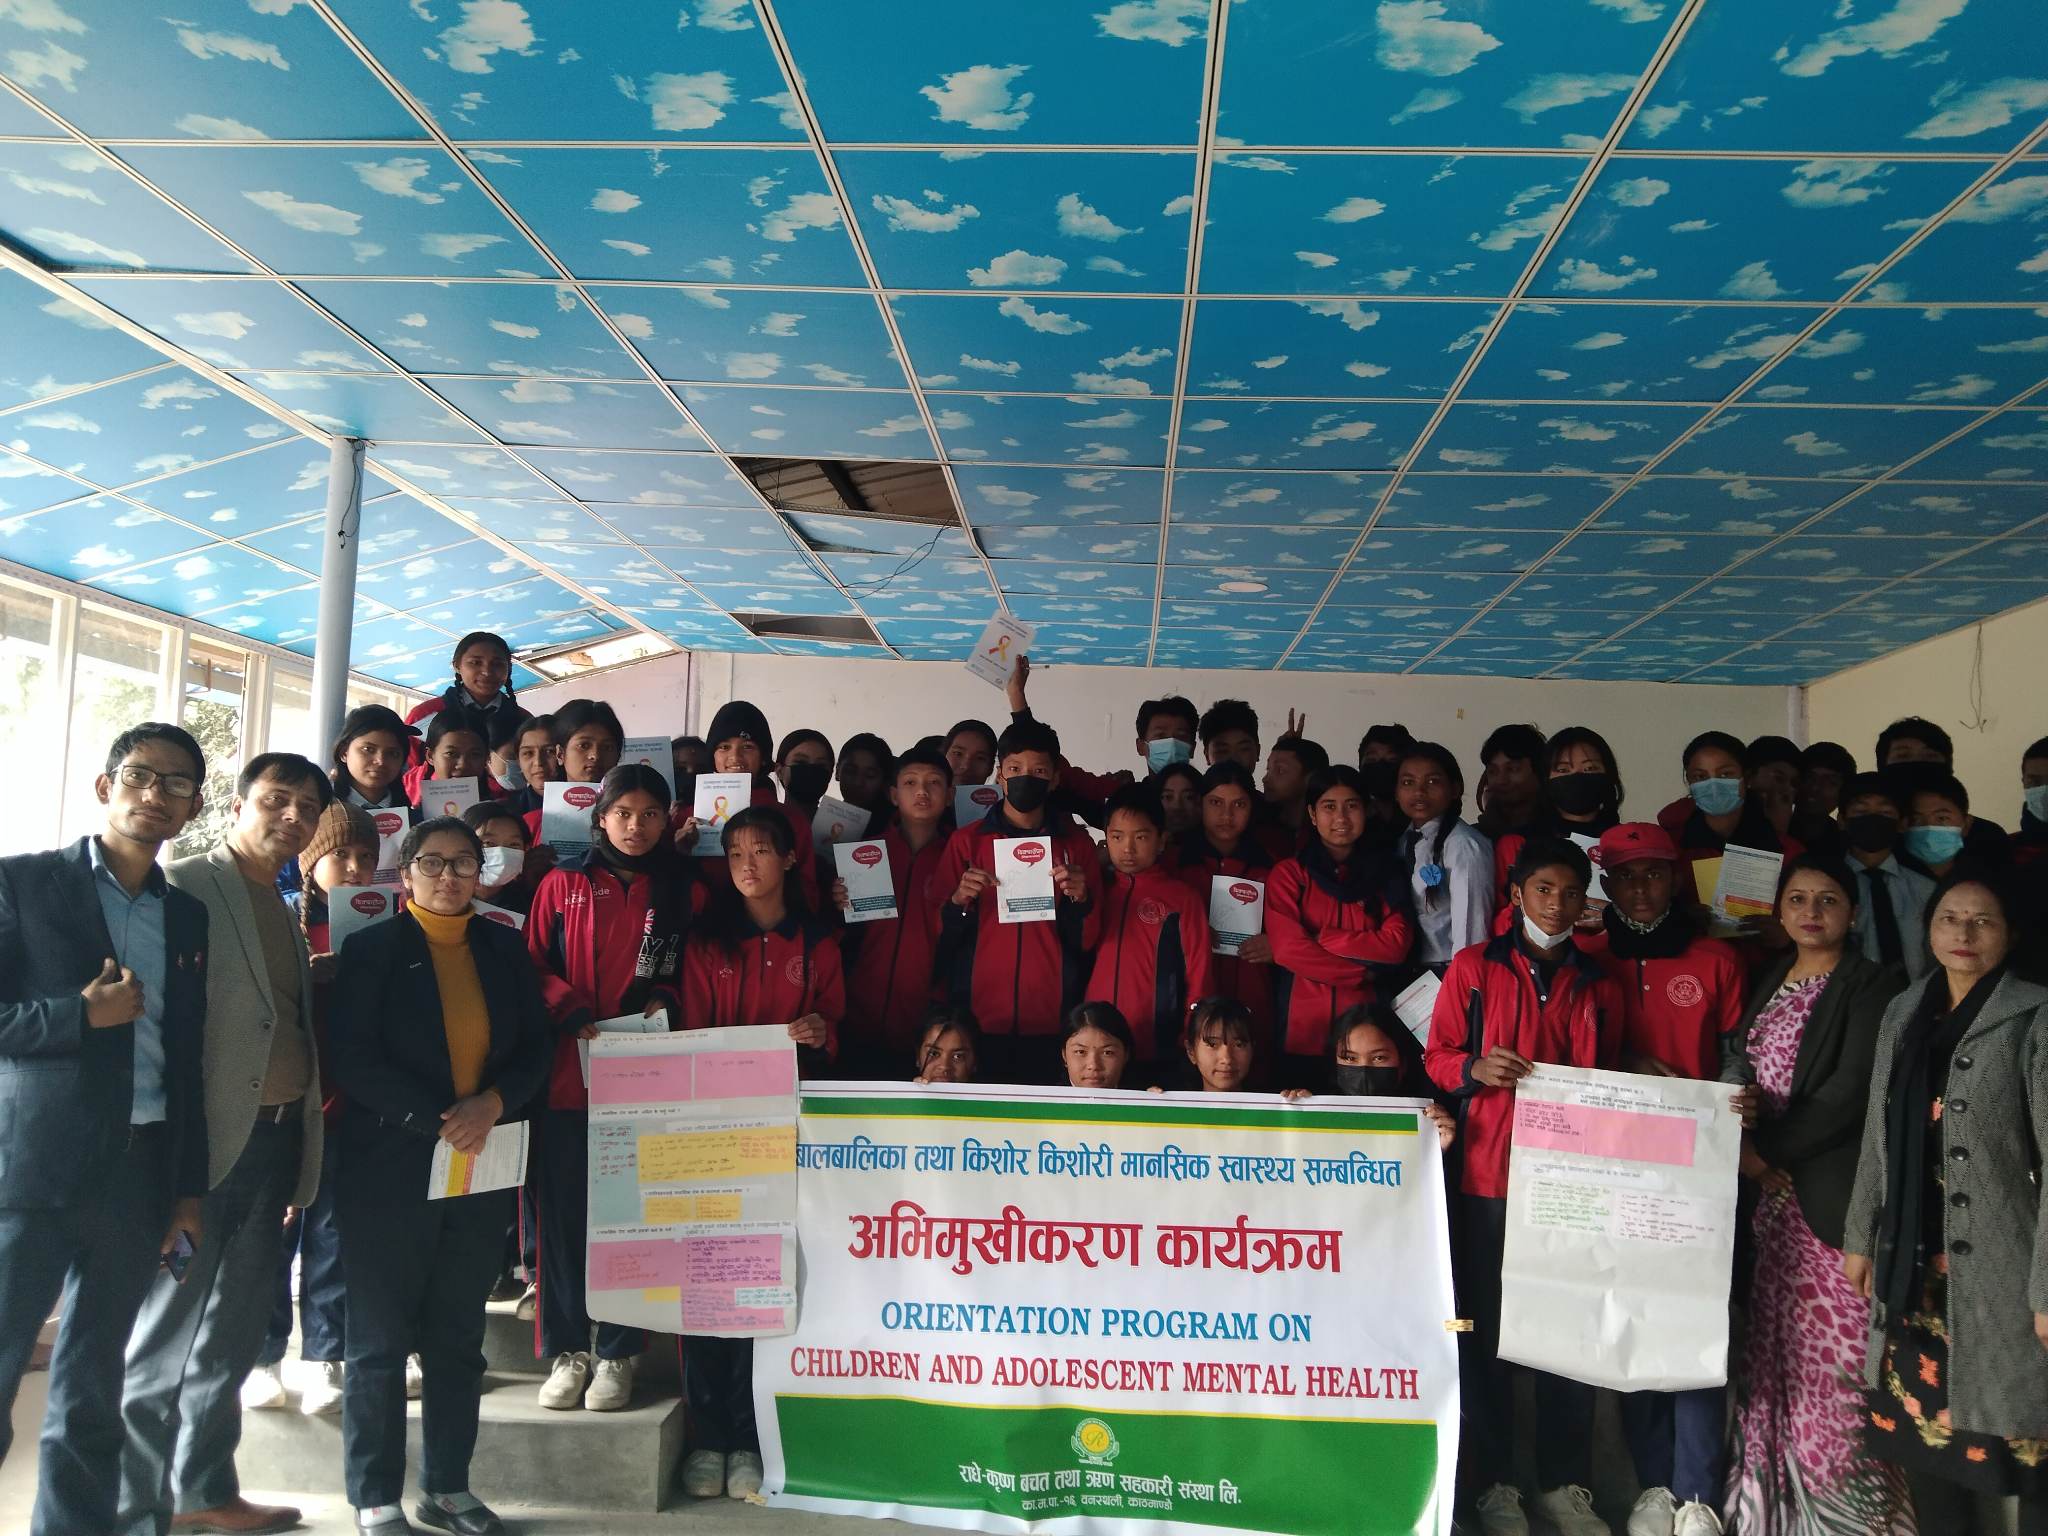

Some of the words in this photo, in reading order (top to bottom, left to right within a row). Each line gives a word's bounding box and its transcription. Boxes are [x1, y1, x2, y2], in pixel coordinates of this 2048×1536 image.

[797, 1135, 907, 1170] बालबालिका
[915, 1145, 956, 1171] तथा
[962, 1137, 1031, 1176] किशोर
[1038, 1139, 1114, 1178] किशोरी
[1120, 1144, 1211, 1181] मानसिक
[1218, 1155, 1296, 1184] स्वास्थ्य
[1303, 1150, 1402, 1187] सम्बन्धित
[848, 1199, 1143, 1276] अभिमुखीकरण
[1156, 1214, 1343, 1274] कार्यक्रम
[880, 1300, 1092, 1338] ORIENTATION
[1100, 1307, 1259, 1342] PROGRAM
[1268, 1311, 1313, 1344] ON
[790, 1347, 920, 1381] CHILDREN
[929, 1354, 983, 1386] AND
[992, 1356, 1174, 1394] ADOLESCENT
[1184, 1362, 1297, 1397] MENTAL
[1306, 1366, 1419, 1401] HEALTH
[1020, 1472, 1050, 1492] बचत
[1055, 1469, 1081, 1489] तथा
[1085, 1470, 1115, 1489] ऋण
[1120, 1474, 1173, 1496] सहकारी
[1178, 1478, 1215, 1501] संस्था
[1219, 1478, 1242, 1504] लि.
